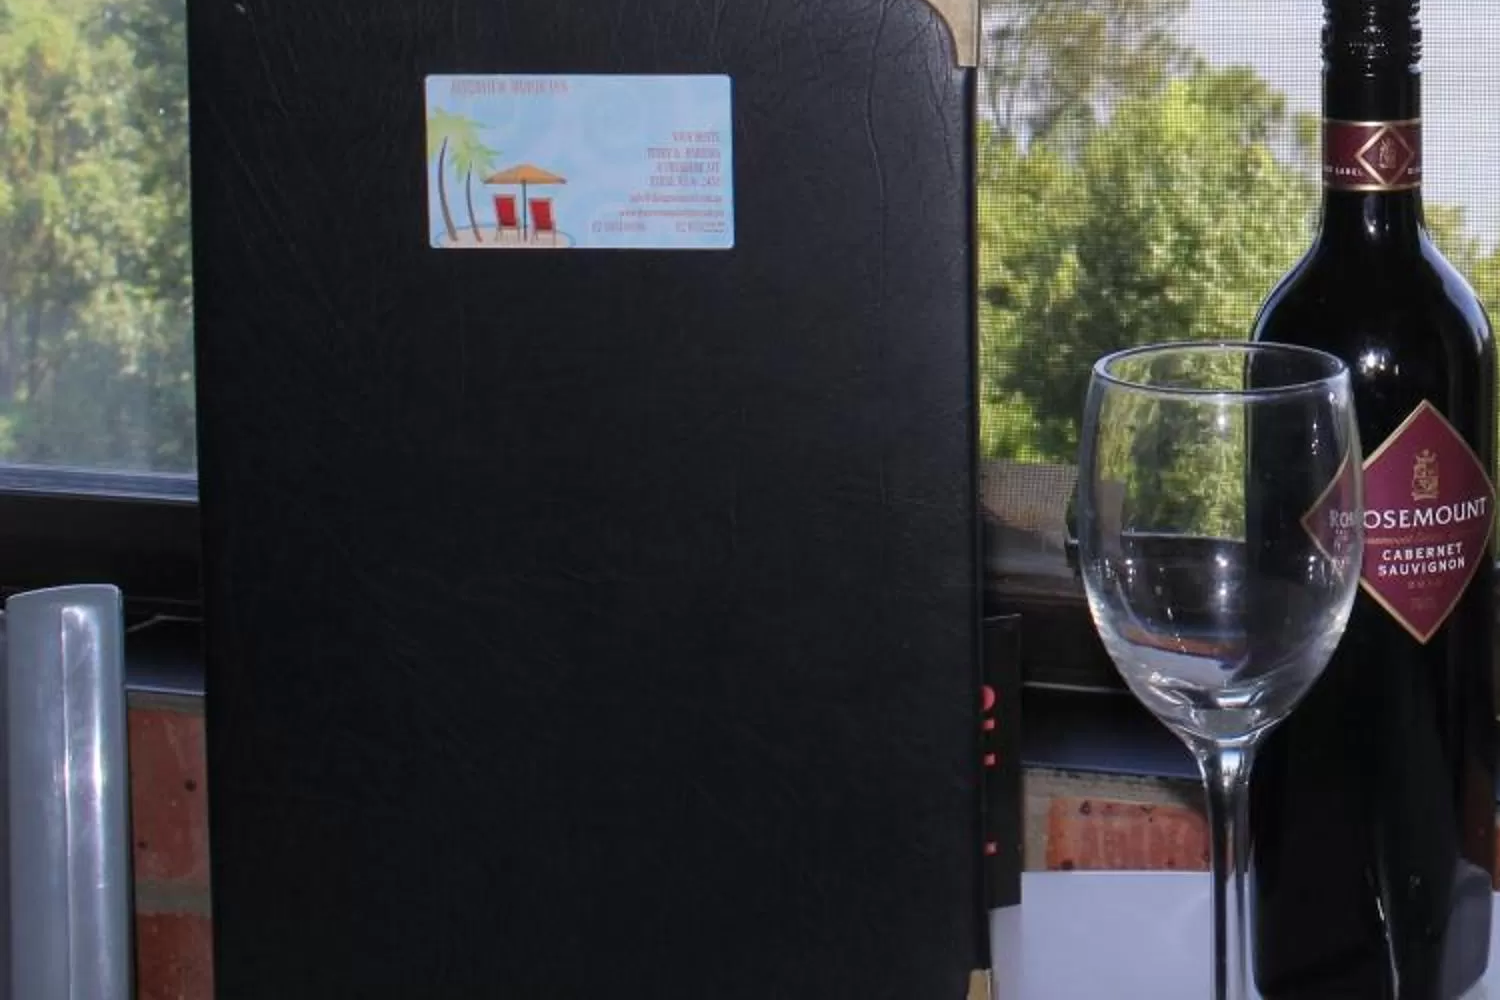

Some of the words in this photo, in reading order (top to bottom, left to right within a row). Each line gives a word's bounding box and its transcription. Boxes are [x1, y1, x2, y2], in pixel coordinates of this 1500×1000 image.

[1362, 497, 1487, 529] OSEMOUNT
[1382, 541, 1463, 561] CABERNET
[1377, 557, 1465, 576] SAUVIGNON
